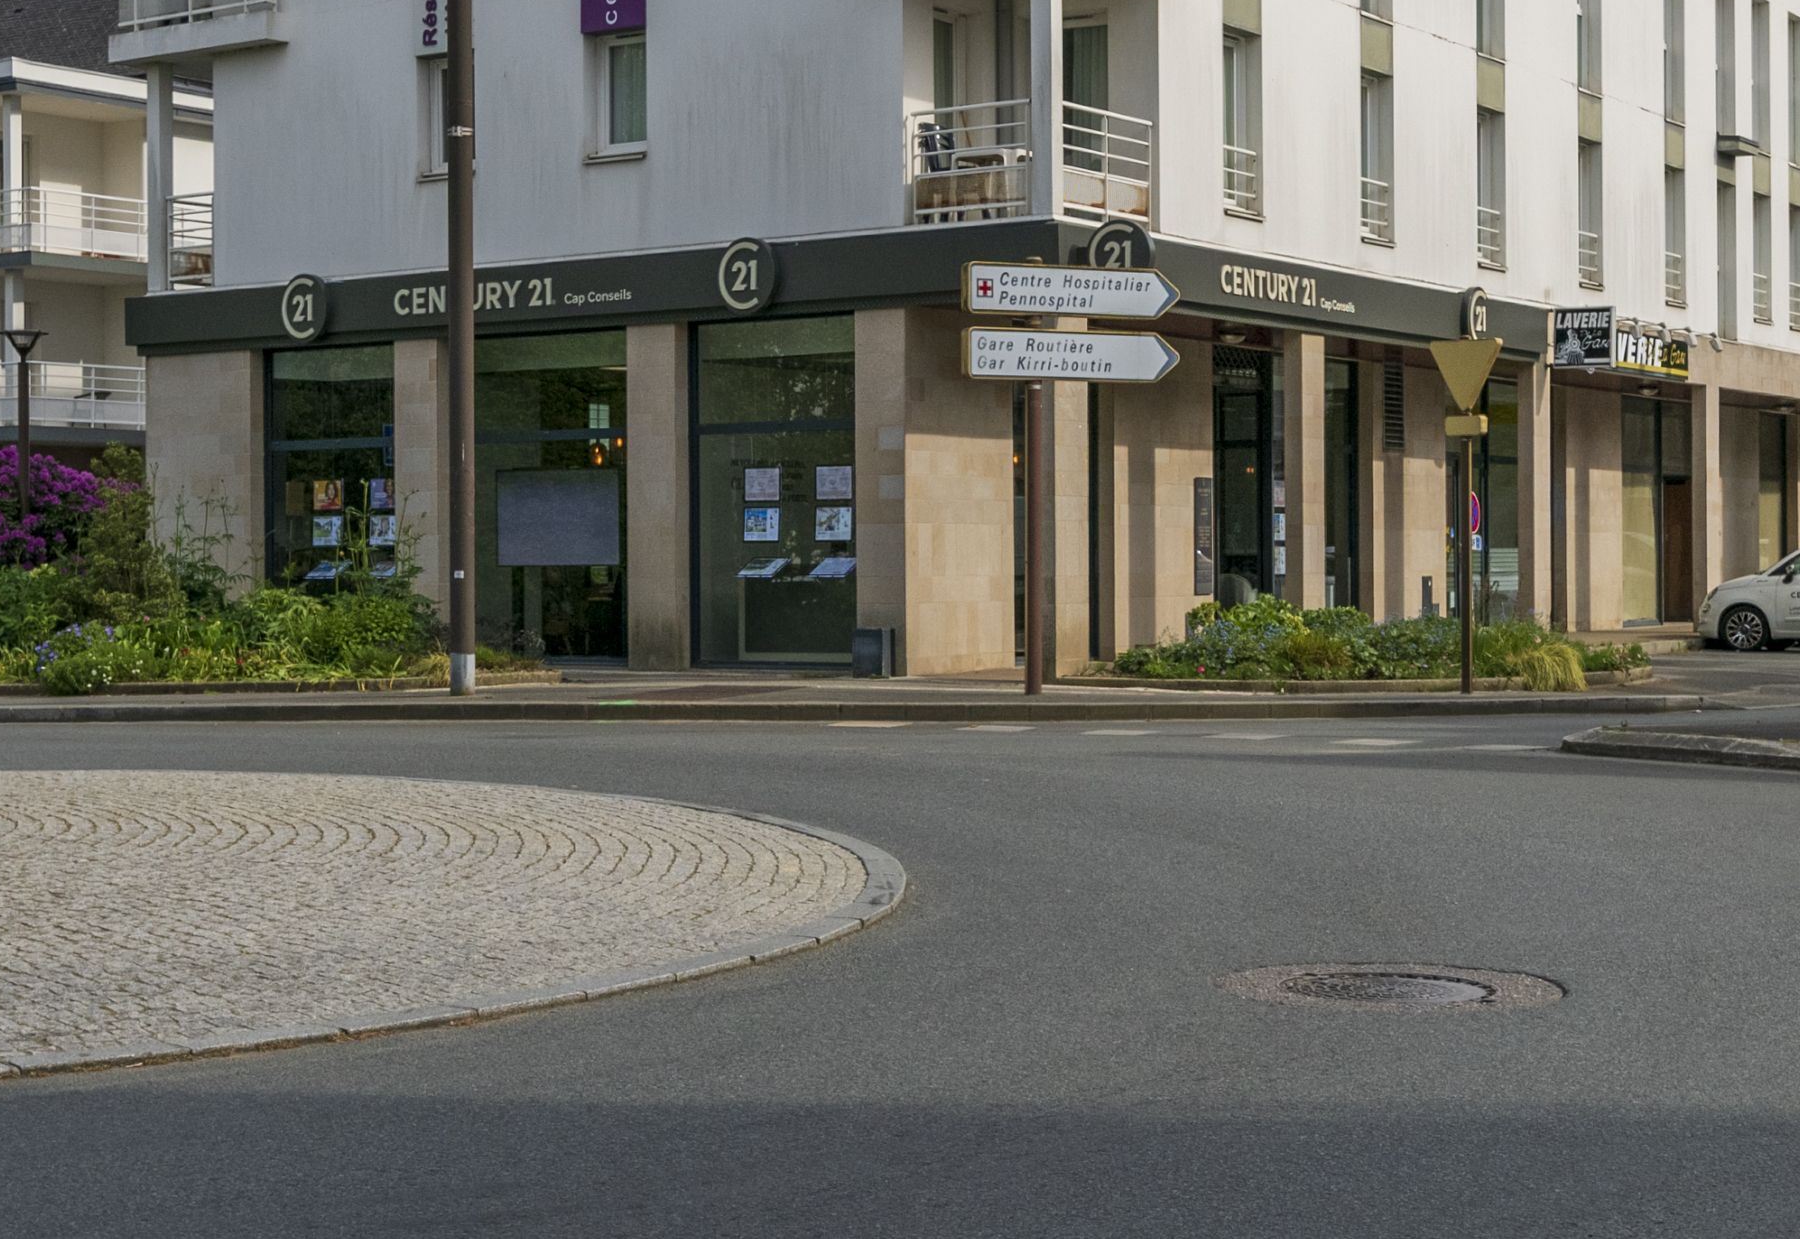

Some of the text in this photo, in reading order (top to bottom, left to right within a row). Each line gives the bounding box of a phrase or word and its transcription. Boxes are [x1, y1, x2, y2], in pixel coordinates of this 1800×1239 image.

[1000, 271, 1151, 292] Centre Hospitalier
[1220, 264, 1355, 314] CENTURY 21 Cap Conseils
[393, 277, 632, 316] CENURY 21 Cap Conseils
[999, 290, 1094, 310] Pennospital
[1556, 312, 1610, 328] LAVERIE
[977, 336, 1094, 354] Gare Routière
[1617, 332, 1664, 367] VERIE
[977, 355, 1112, 373] Gar Kirri-boutin
